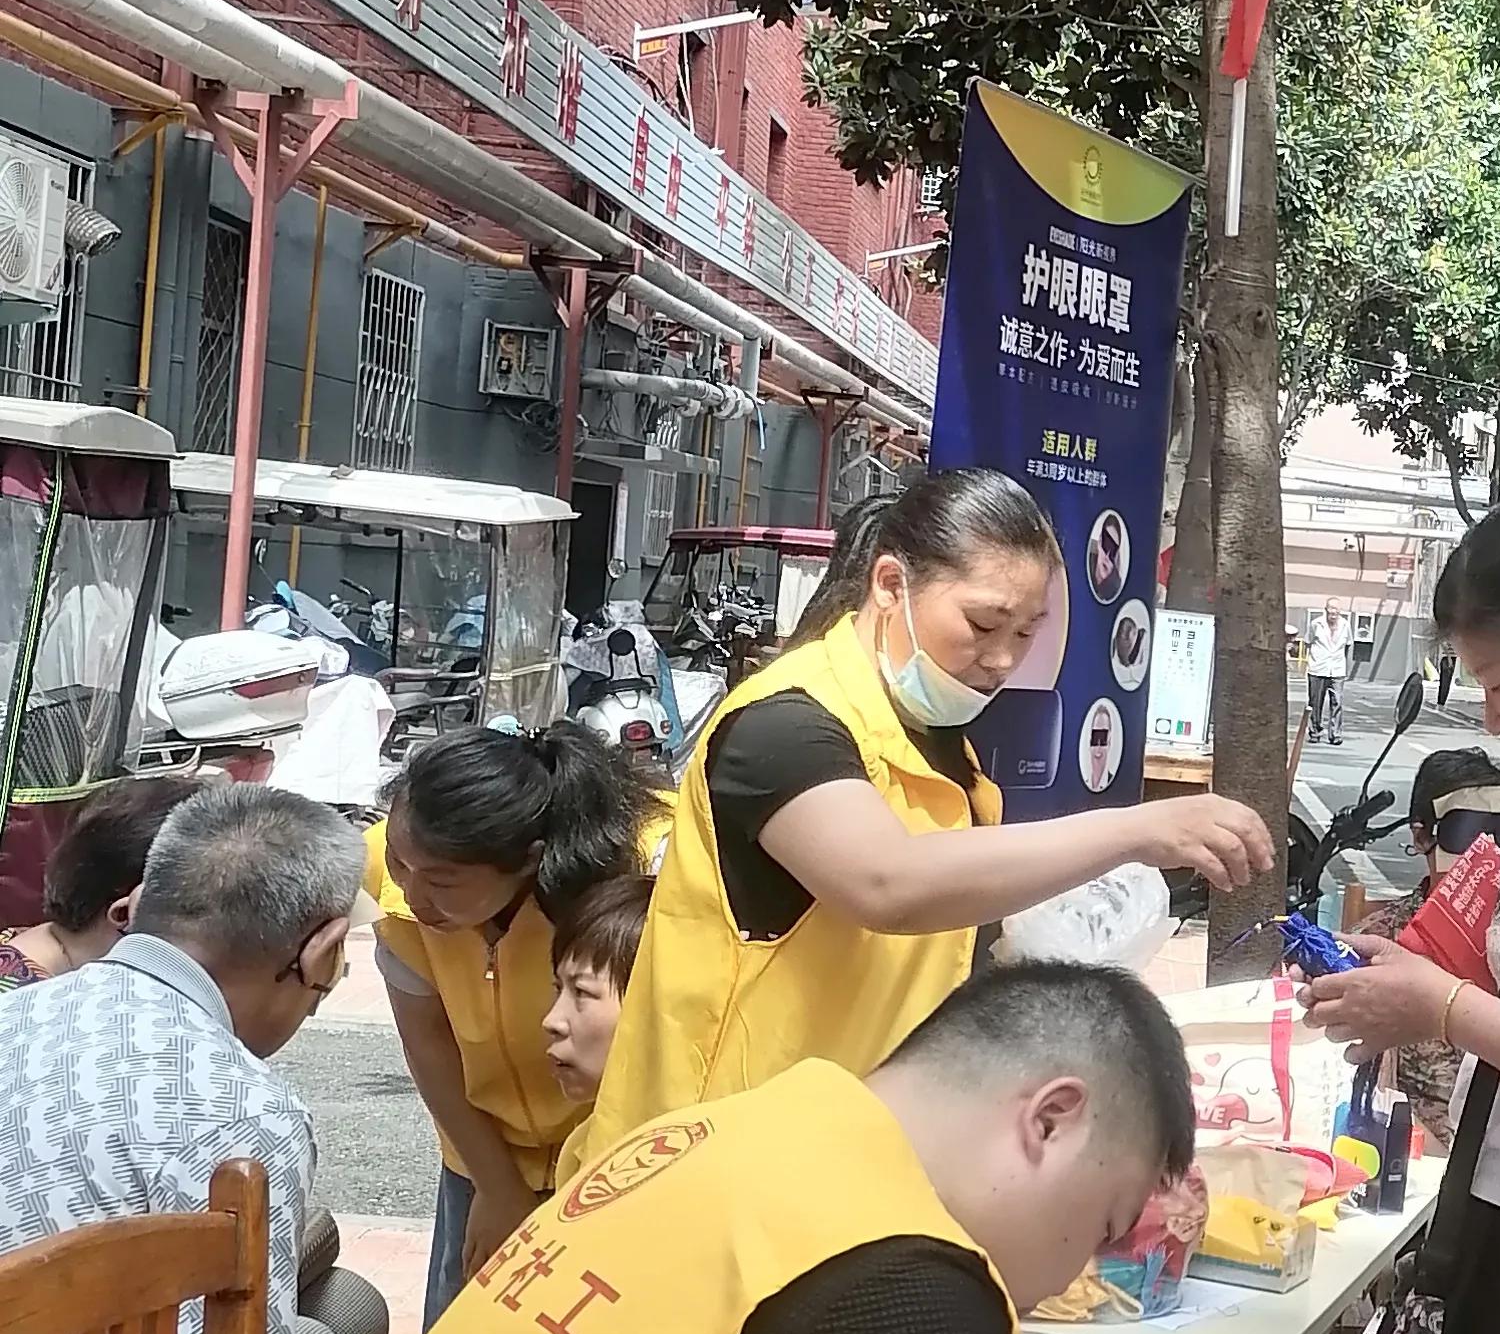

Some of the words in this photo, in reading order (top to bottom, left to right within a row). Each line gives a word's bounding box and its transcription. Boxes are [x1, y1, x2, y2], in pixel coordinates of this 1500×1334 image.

[1022, 243, 1132, 333] 护眼眼罩
[1042, 429, 1097, 462] 适用人群
